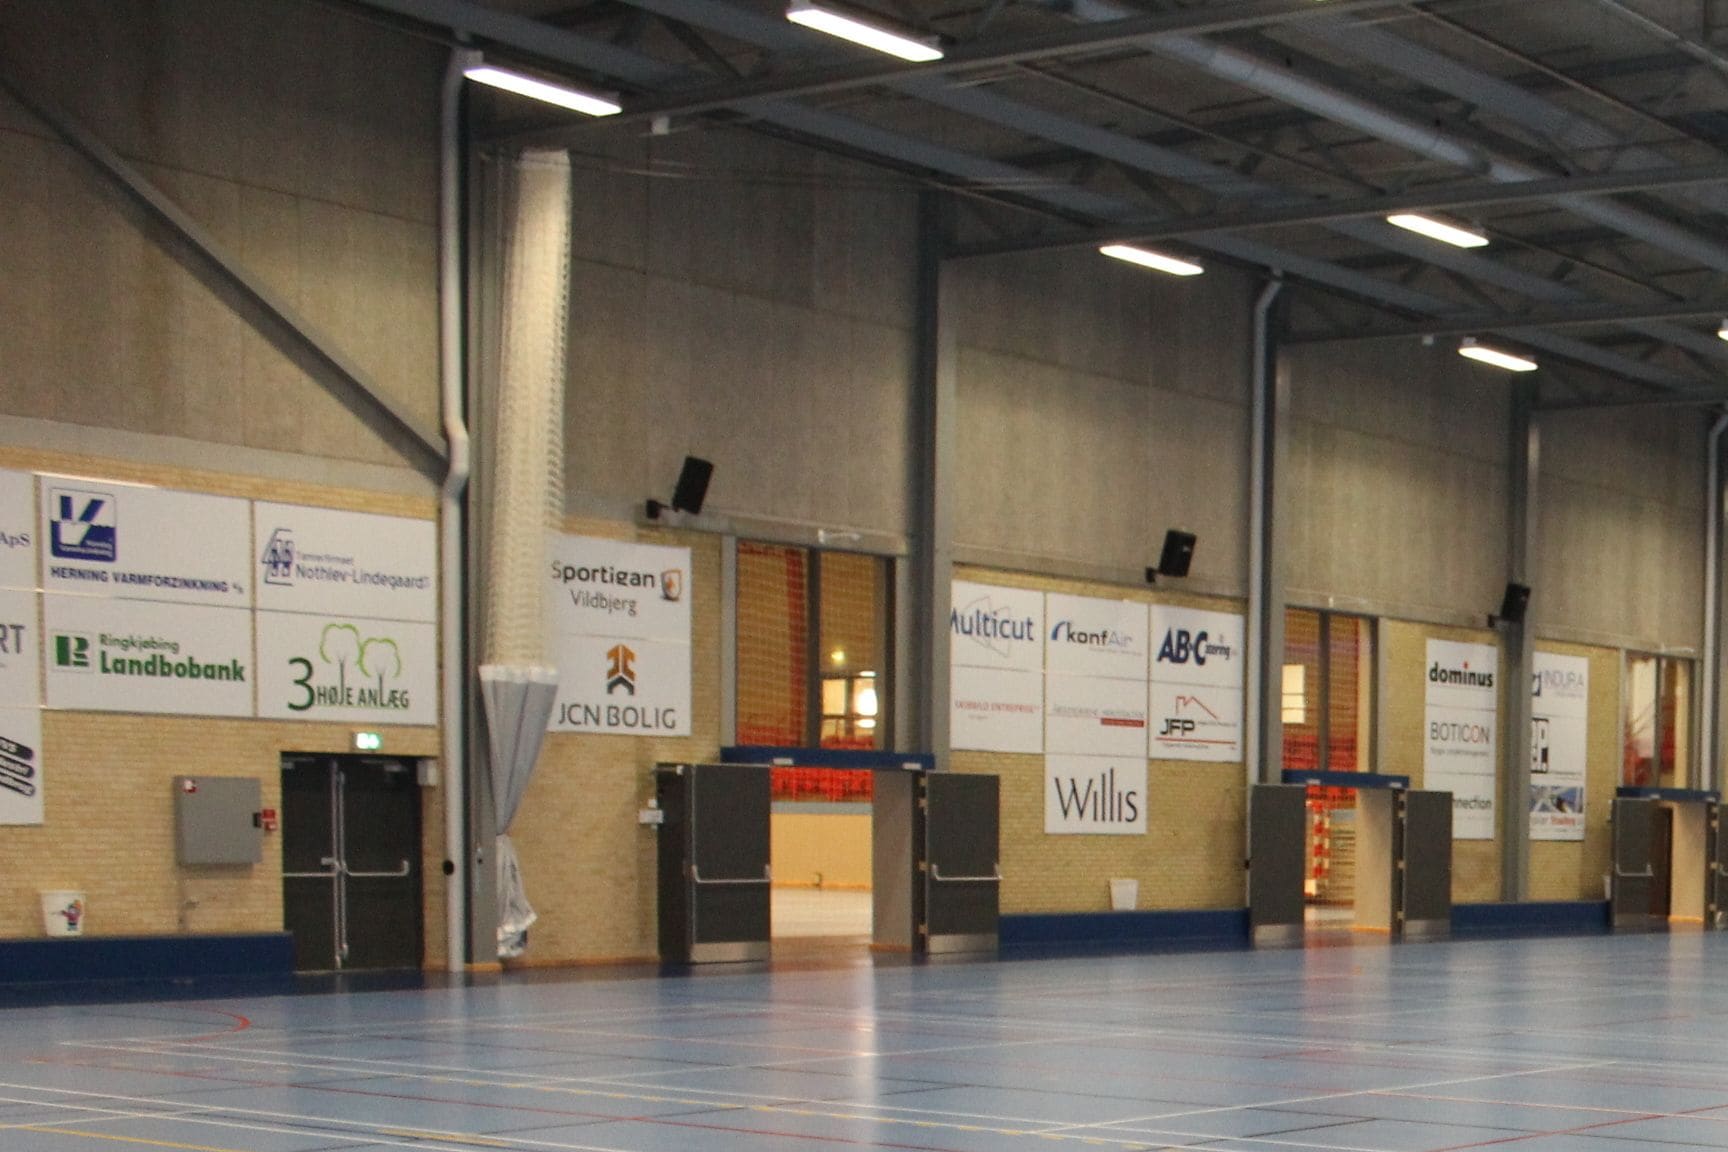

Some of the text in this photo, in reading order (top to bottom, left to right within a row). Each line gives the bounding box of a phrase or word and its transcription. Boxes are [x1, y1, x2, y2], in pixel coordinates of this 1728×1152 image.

[51, 564, 109, 583] HERNING
[113, 572, 228, 593] VARMFORZINKNING
[551, 559, 656, 590] Sportigan
[570, 588, 638, 618] Vildbjerg
[100, 634, 180, 660] Ringkjøbing
[100, 653, 246, 682] Landbobank
[1429, 661, 1493, 688] dominus
[287, 657, 315, 712] 3
[557, 702, 677, 730] JCN BOLIG
[1159, 718, 1196, 737] JFP
[1431, 722, 1490, 745] BOTICON
[1054, 767, 1139, 824] Willis
[1453, 796, 1492, 811] nection
